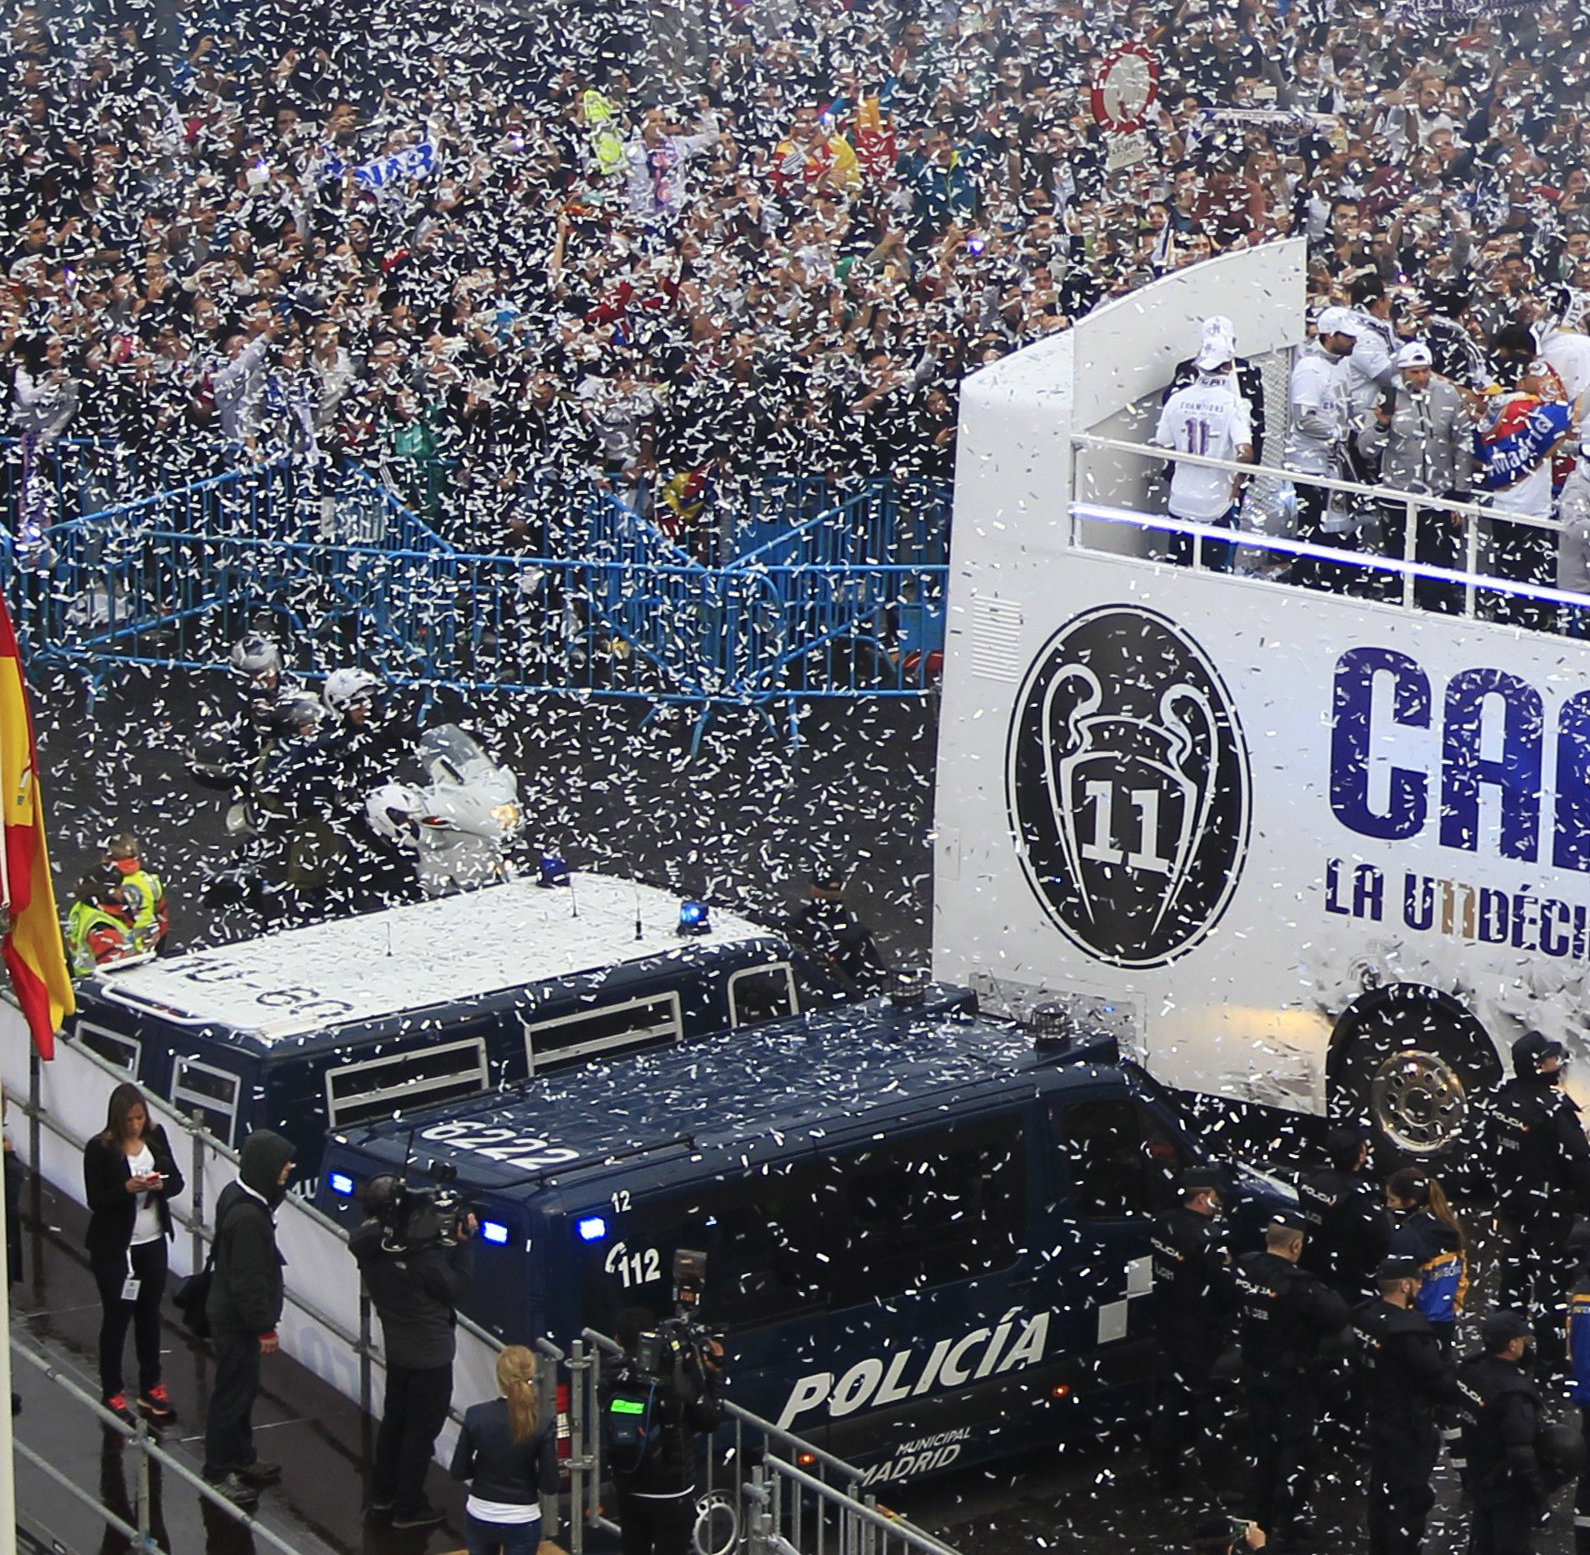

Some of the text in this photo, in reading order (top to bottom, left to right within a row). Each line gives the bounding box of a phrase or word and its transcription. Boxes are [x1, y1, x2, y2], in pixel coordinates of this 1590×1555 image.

[1081, 780, 1171, 875] 11
[1325, 857, 1384, 922] LA
[421, 1120, 580, 1171] 6222
[611, 1190, 632, 1214] 12
[617, 1248, 662, 1289] 112
[775, 1305, 1051, 1431] POLICÍA
[895, 1426, 971, 1457] MUNICIPAL
[858, 1444, 961, 1487] MADRID
